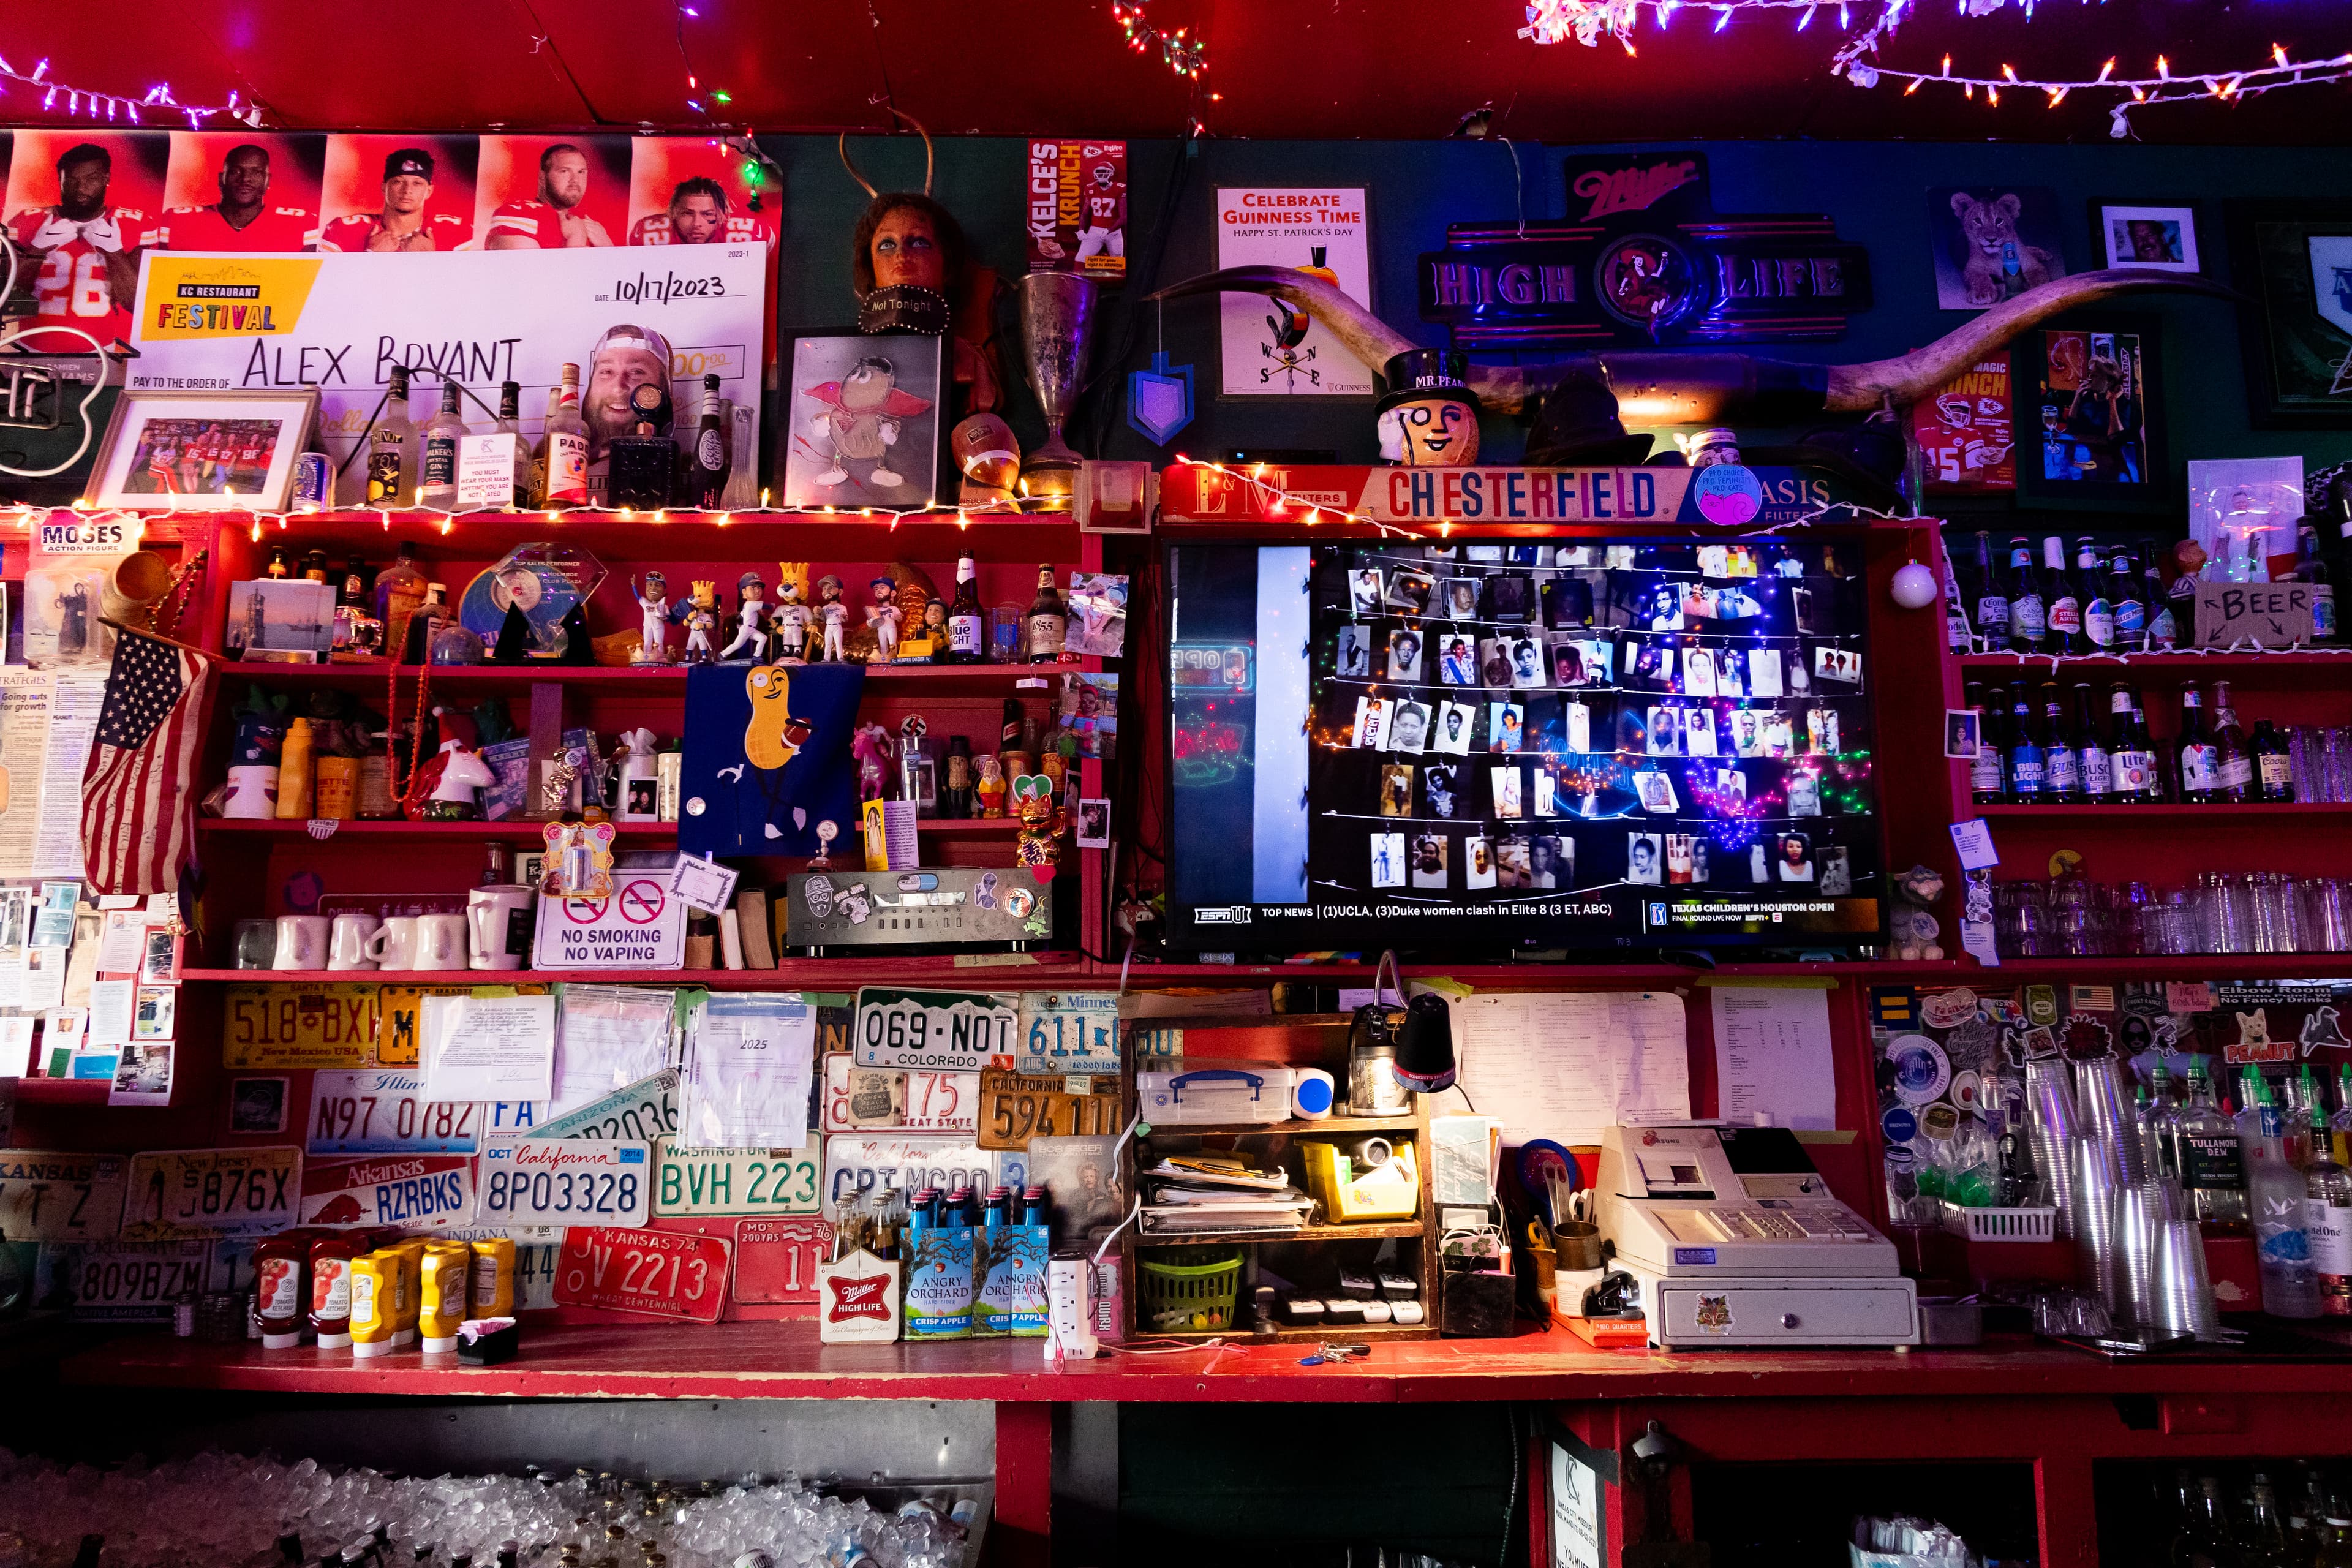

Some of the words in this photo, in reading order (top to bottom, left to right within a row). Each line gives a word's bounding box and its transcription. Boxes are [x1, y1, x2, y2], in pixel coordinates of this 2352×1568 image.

[1031, 143, 1058, 238] KELCE'S
[1059, 145, 1080, 225] KRUNCH
[1090, 197, 1116, 217] 87
[1242, 193, 1341, 208] CELEBRATE
[1223, 209, 1312, 225] GUINNESS
[1317, 209, 1361, 225] TIME
[1234, 228, 1264, 238] HAPPY
[1267, 228, 1281, 237] ST.
[1284, 228, 1332, 238] PATRICK'S
[1334, 228, 1354, 237] DAY
[35, 249, 111, 318] 26
[1432, 261, 1577, 306] HIGH
[1716, 254, 1845, 298] LIFE
[181, 287, 194, 297] KC
[197, 287, 258, 298] RESTAURANT
[614, 271, 726, 306] 10/17/2023
[595, 294, 609, 303] DATE
[872, 300, 887, 312] Not
[888, 298, 931, 313] Tonight
[158, 303, 276, 331] FESTIVAL
[1260, 342, 1272, 358] W
[1307, 346, 1317, 361] N
[242, 337, 352, 387] ALEX
[374, 336, 522, 385] BRYANT
[1973, 362, 2007, 373] MAGIC
[133, 377, 150, 389] PAY
[153, 377, 164, 389] TO
[167, 377, 184, 390] THE
[186, 378, 214, 390] ORDER
[216, 379, 230, 390] OF
[1260, 368, 1270, 385] S
[1310, 370, 1321, 386] E
[1335, 383, 1371, 392] GUINNESS
[1388, 470, 1656, 519] CHESTERFIELD
[43, 525, 123, 544] MOSES
[2222, 590, 2308, 620] BEER
[1032, 619, 1054, 631] 1855
[2, 692, 27, 703] Going
[15, 703, 47, 712] growth
[2016, 761, 2043, 772] BUD
[2122, 755, 2144, 769] Lite
[1262, 908, 1283, 917] TOP
[1284, 908, 1313, 917] NEWS
[1323, 906, 1373, 918] (1)UCLA,
[1374, 906, 1420, 918] (3)Duke
[1422, 907, 1464, 916] women
[1466, 905, 1496, 916] clash
[1498, 905, 1508, 916] in
[1511, 905, 1537, 915] Elite
[1539, 905, 1547, 915] 8
[1550, 904, 1562, 917] (3
[1564, 904, 1581, 916] ET,
[1583, 903, 1612, 916] ABC)
[1671, 904, 1702, 913] TEXAS
[1703, 903, 1759, 913] CHILDREN'S
[1759, 903, 1807, 912] HOUSTON
[1808, 903, 1835, 912] OPEN
[561, 929, 583, 943] NO
[587, 929, 662, 943] SMOKING
[564, 946, 587, 960] NO
[591, 946, 655, 960] VAPING
[392, 1009, 413, 1047] M
[865, 1010, 927, 1049] 069
[950, 1013, 1012, 1053] NOT
[740, 1039, 769, 1049] 2025
[1028, 1016, 1091, 1057] 611
[334, 1047, 360, 1055] USA
[2226, 1042, 2294, 1063] PEANUT
[898, 1053, 978, 1067] COLORADO
[992, 1079, 1064, 1092] CALIFORNIA
[559, 1093, 638, 1131] ARIZONA
[1038, 1145, 1063, 1154] BOB
[1065, 1144, 1103, 1153] SEGER
[2190, 1139, 2239, 1148] TULLAMORE
[176, 1155, 209, 1169] New
[211, 1154, 255, 1170] Jersey
[488, 1148, 512, 1159] OCT
[516, 1145, 619, 1170] California
[345, 1159, 424, 1188] Arkansas
[203, 1167, 290, 1214] 876X
[662, 1163, 731, 1205] BVH
[747, 1161, 815, 1204] 223
[375, 1171, 462, 1224] RZRBKS
[488, 1170, 638, 1213] 8P03328
[447, 1228, 509, 1242] INDIANA
[742, 1233, 780, 1243] 200YRS
[2322, 1226, 2342, 1236] One
[604, 1231, 671, 1252] KANSAS
[671, 1237, 698, 1252] 74
[922, 1276, 963, 1287] ANGRY
[997, 1273, 1039, 1285] ANGRY
[841, 1283, 878, 1304] Miller
[911, 1287, 969, 1299] ORCHARD
[625, 1295, 681, 1312] CENTENNIAL
[837, 1304, 861, 1313] HIGH
[862, 1303, 882, 1311] LIFE
[75, 1308, 107, 1318] NATIVE
[110, 1308, 157, 1318] AMERICA
[1020, 1313, 1043, 1322] APPLE
[1098, 1300, 1111, 1332] QUIRK
[915, 1317, 940, 1327] CRISP
[940, 1316, 967, 1325] APPLE
